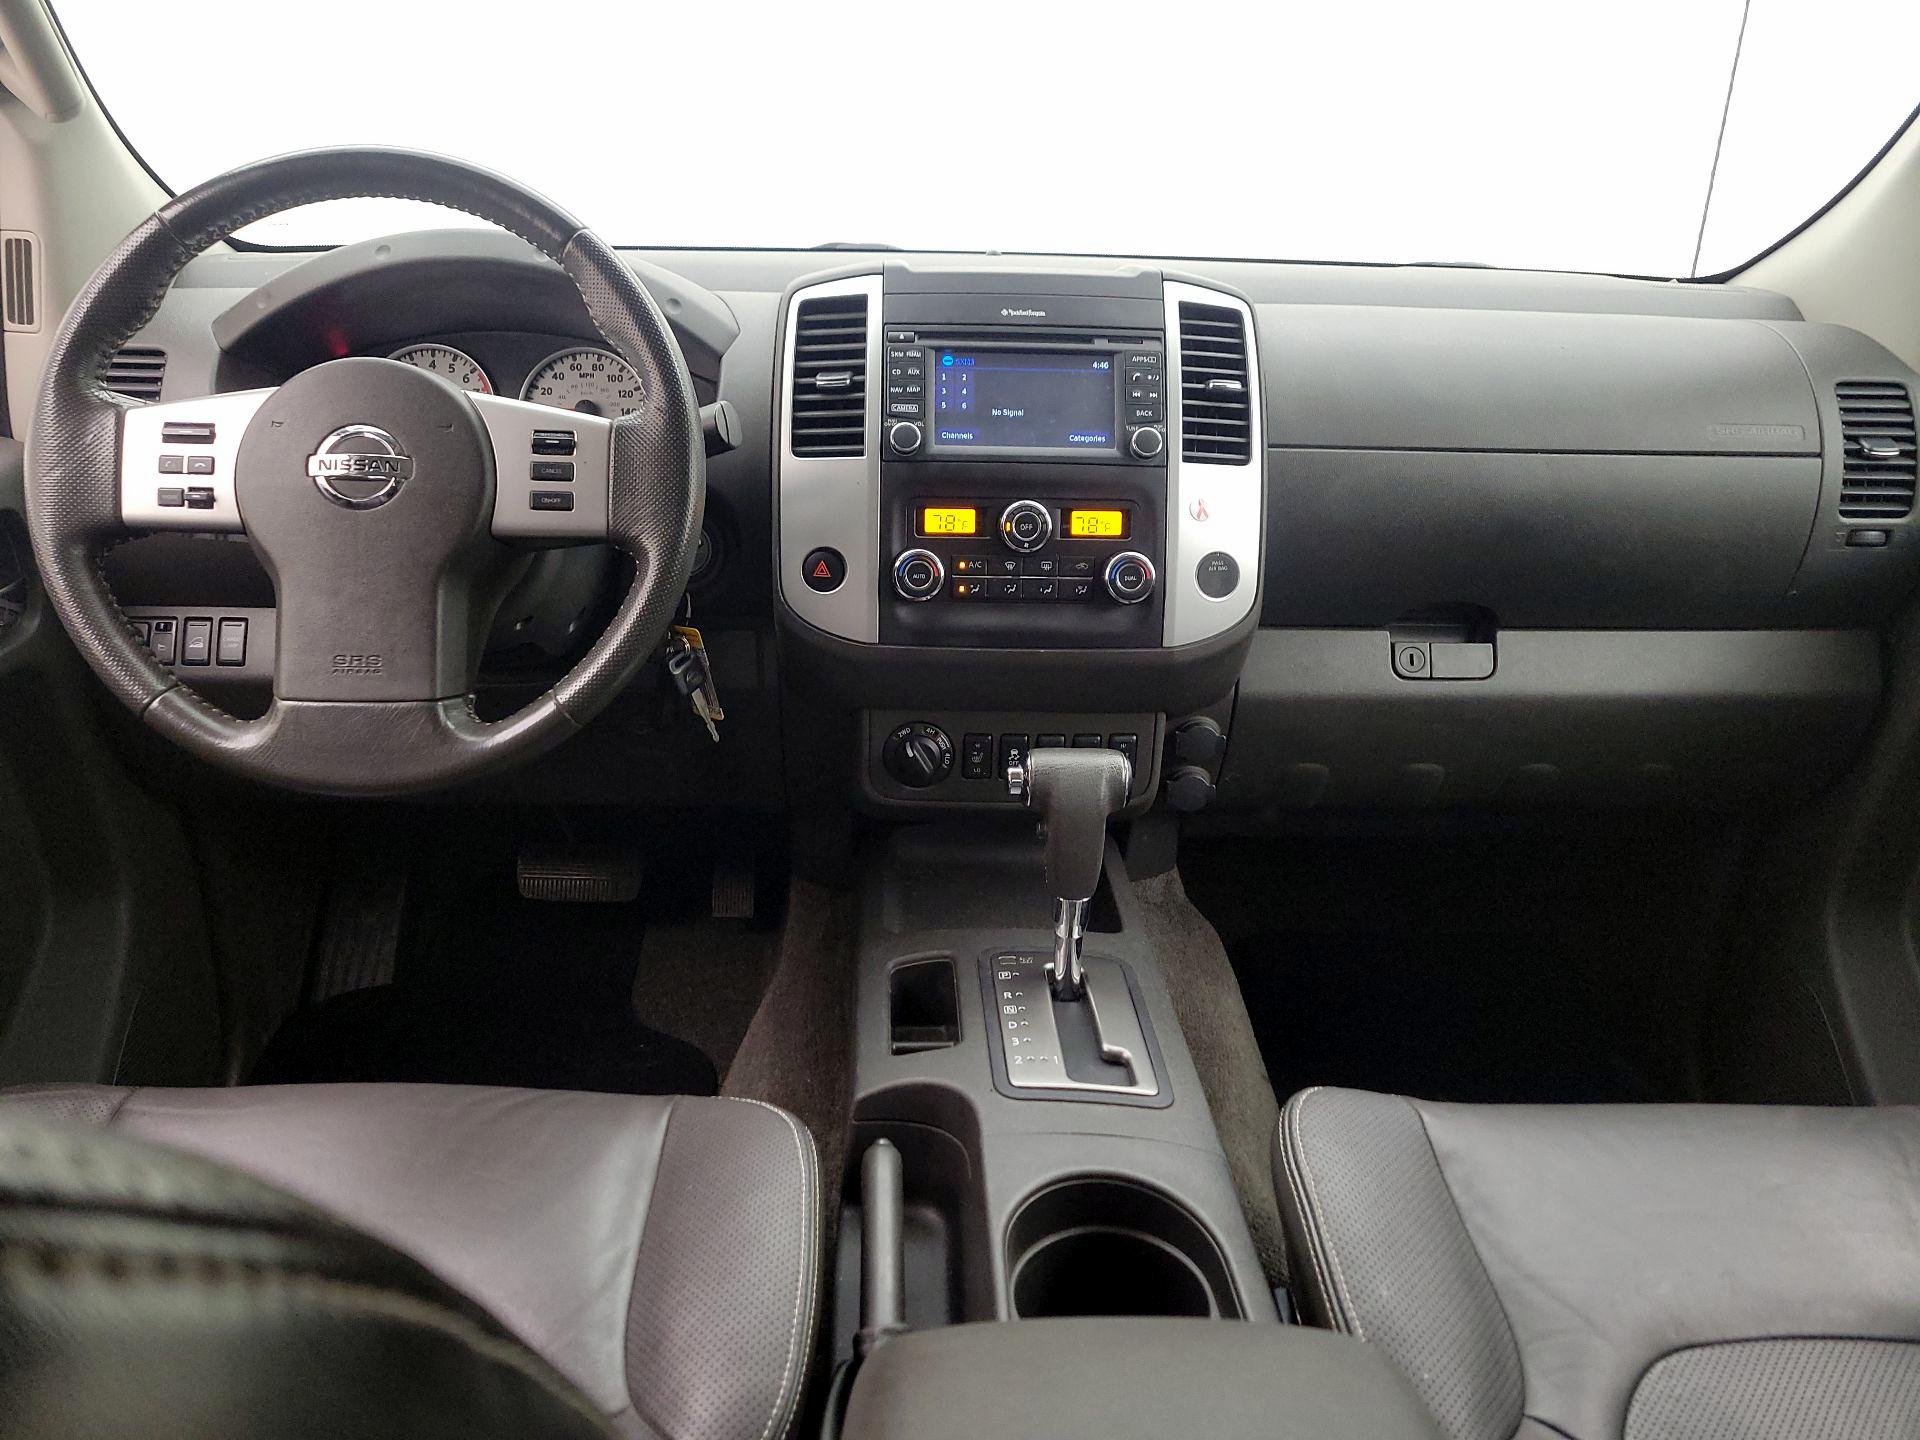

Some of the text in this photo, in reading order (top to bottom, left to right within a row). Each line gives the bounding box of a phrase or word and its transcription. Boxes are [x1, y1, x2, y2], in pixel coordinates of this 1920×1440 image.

[429, 360, 437, 369] 4
[448, 363, 456, 374] 5
[569, 363, 582, 371] 60
[591, 363, 605, 371] 80
[552, 372, 565, 381] 40
[891, 368, 902, 376] CD
[907, 368, 921, 376] AUX
[462, 373, 470, 384] 6
[607, 374, 624, 383] 100
[941, 373, 967, 381] 1 2
[540, 387, 553, 396] 20
[617, 390, 634, 399] 120
[941, 387, 967, 395] 3 4
[941, 401, 967, 410] 5 6
[991, 408, 1025, 418] No Signal
[1136, 409, 1153, 417] BACK
[941, 431, 974, 440] Channels
[1069, 434, 1106, 443] Categories
[318, 458, 401, 473] NISSAN
[1019, 523, 1033, 531] OFF
[897, 727, 911, 738] 2WD
[925, 727, 936, 735] 4H
[1003, 991, 1013, 999] R
[1008, 1021, 1018, 1029] D
[1011, 1037, 1020, 1046] 3
[1014, 1055, 1059, 1065] 2 1
